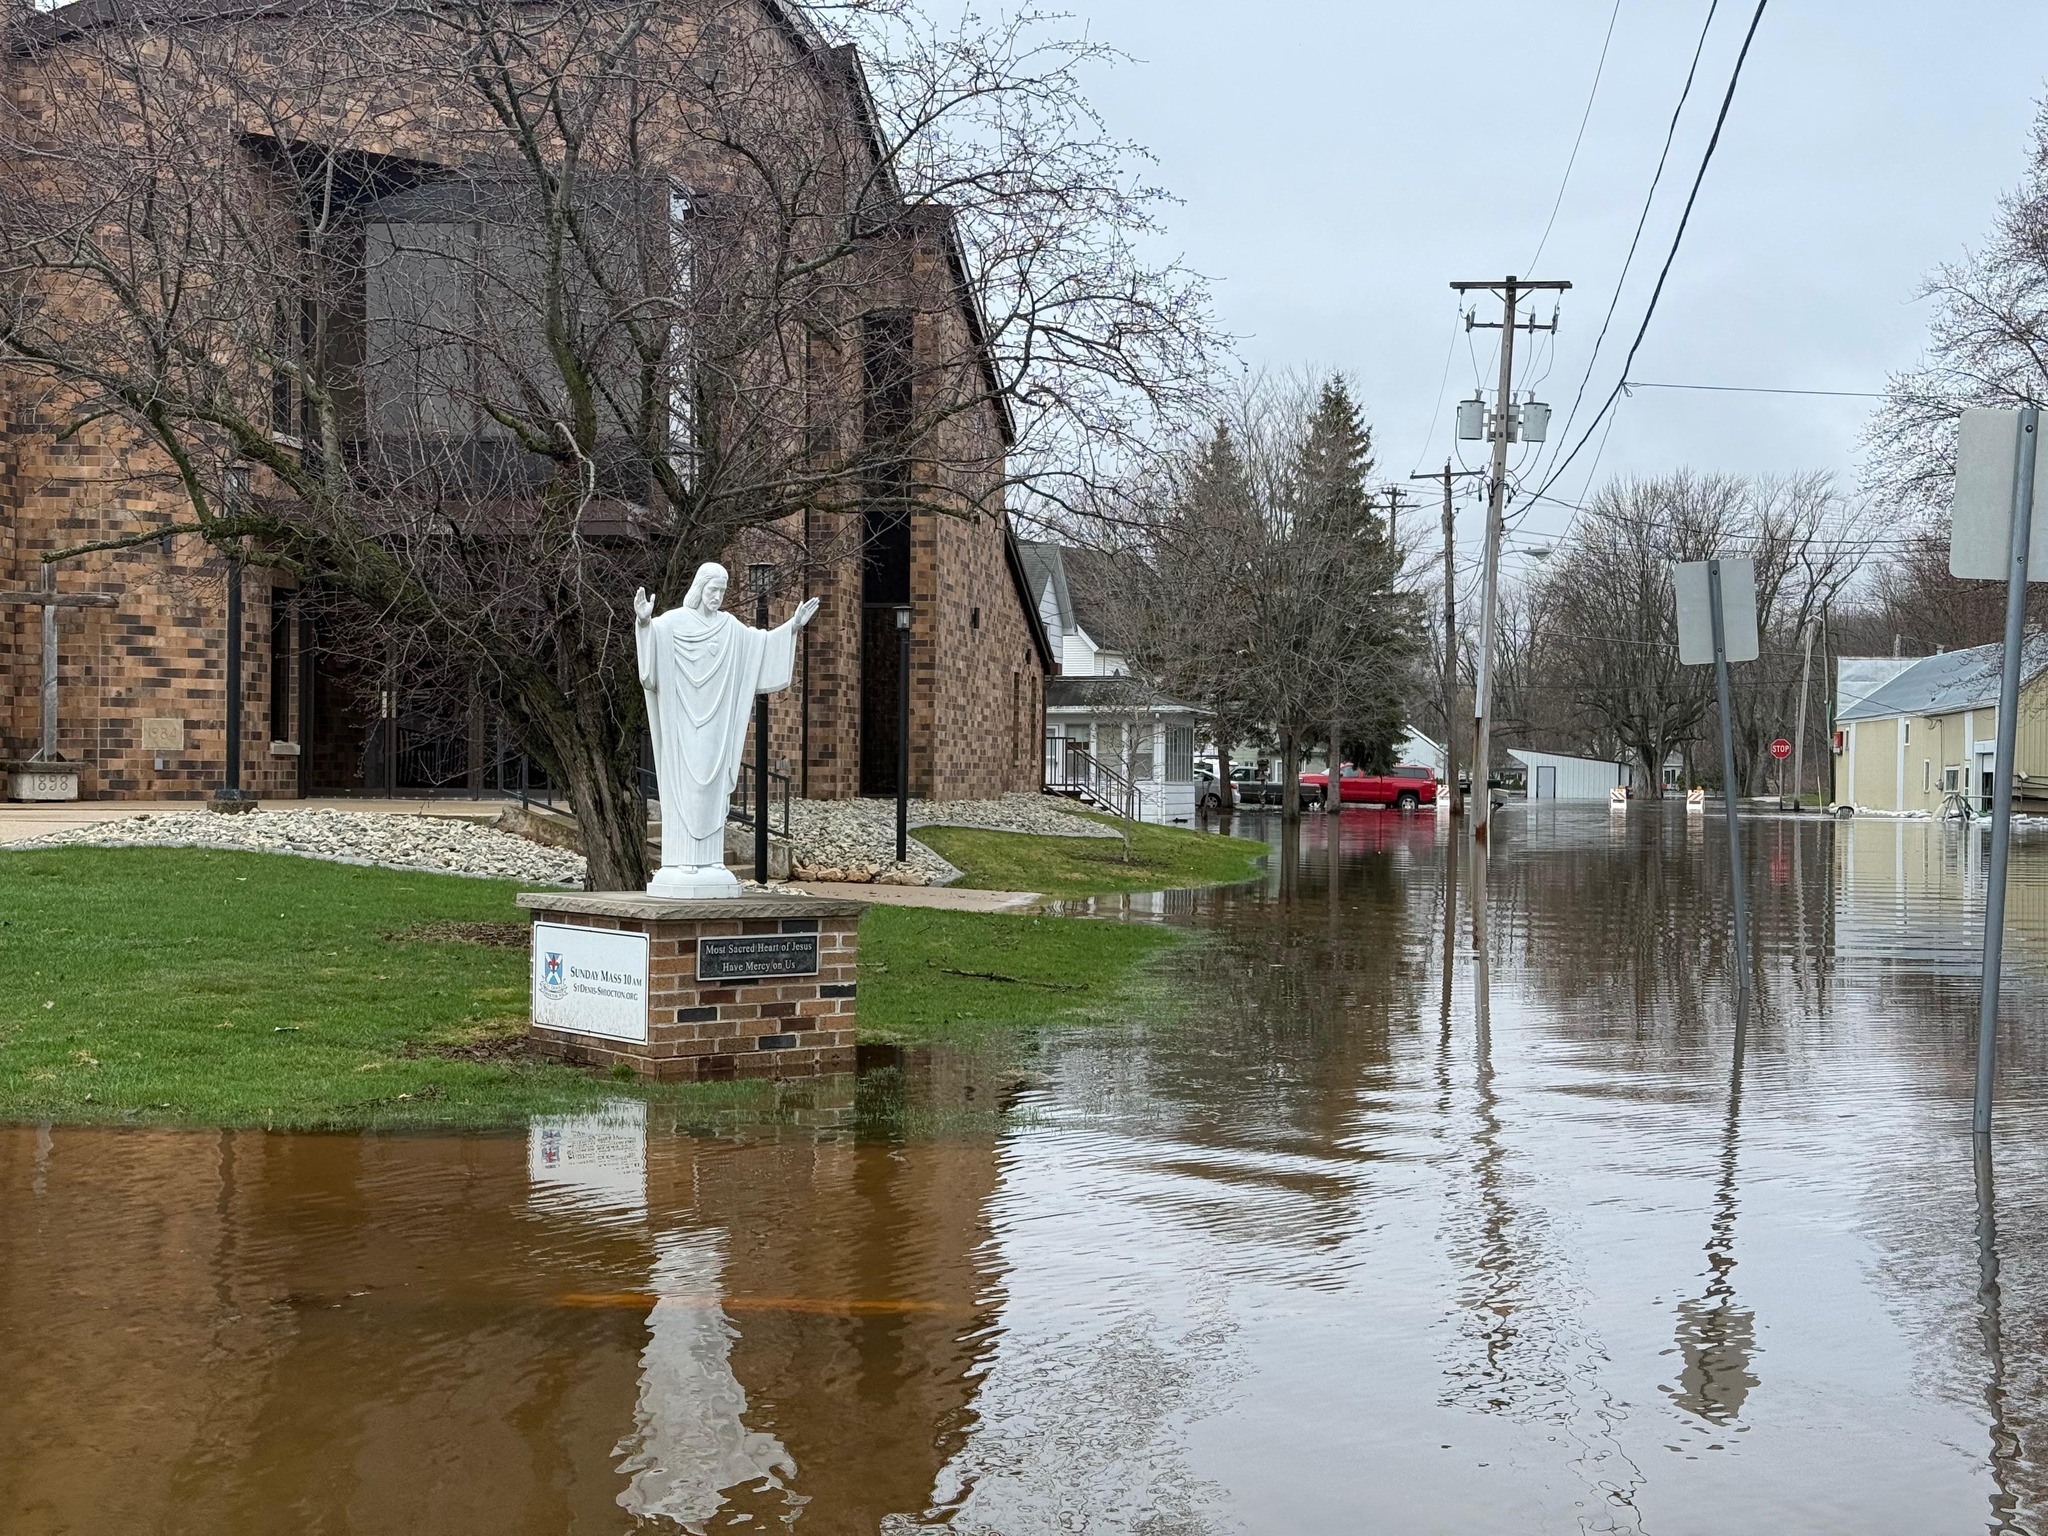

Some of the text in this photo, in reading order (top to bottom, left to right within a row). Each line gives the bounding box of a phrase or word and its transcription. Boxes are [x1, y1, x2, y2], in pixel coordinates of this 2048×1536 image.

[772, 745, 790, 753] STOP
[31, 774, 69, 791] 1898
[705, 941, 812, 955] Most Sacred Heart of Jesus
[722, 962, 743, 972] Have
[745, 961, 770, 972] Mercy
[785, 960, 796, 970] Us
